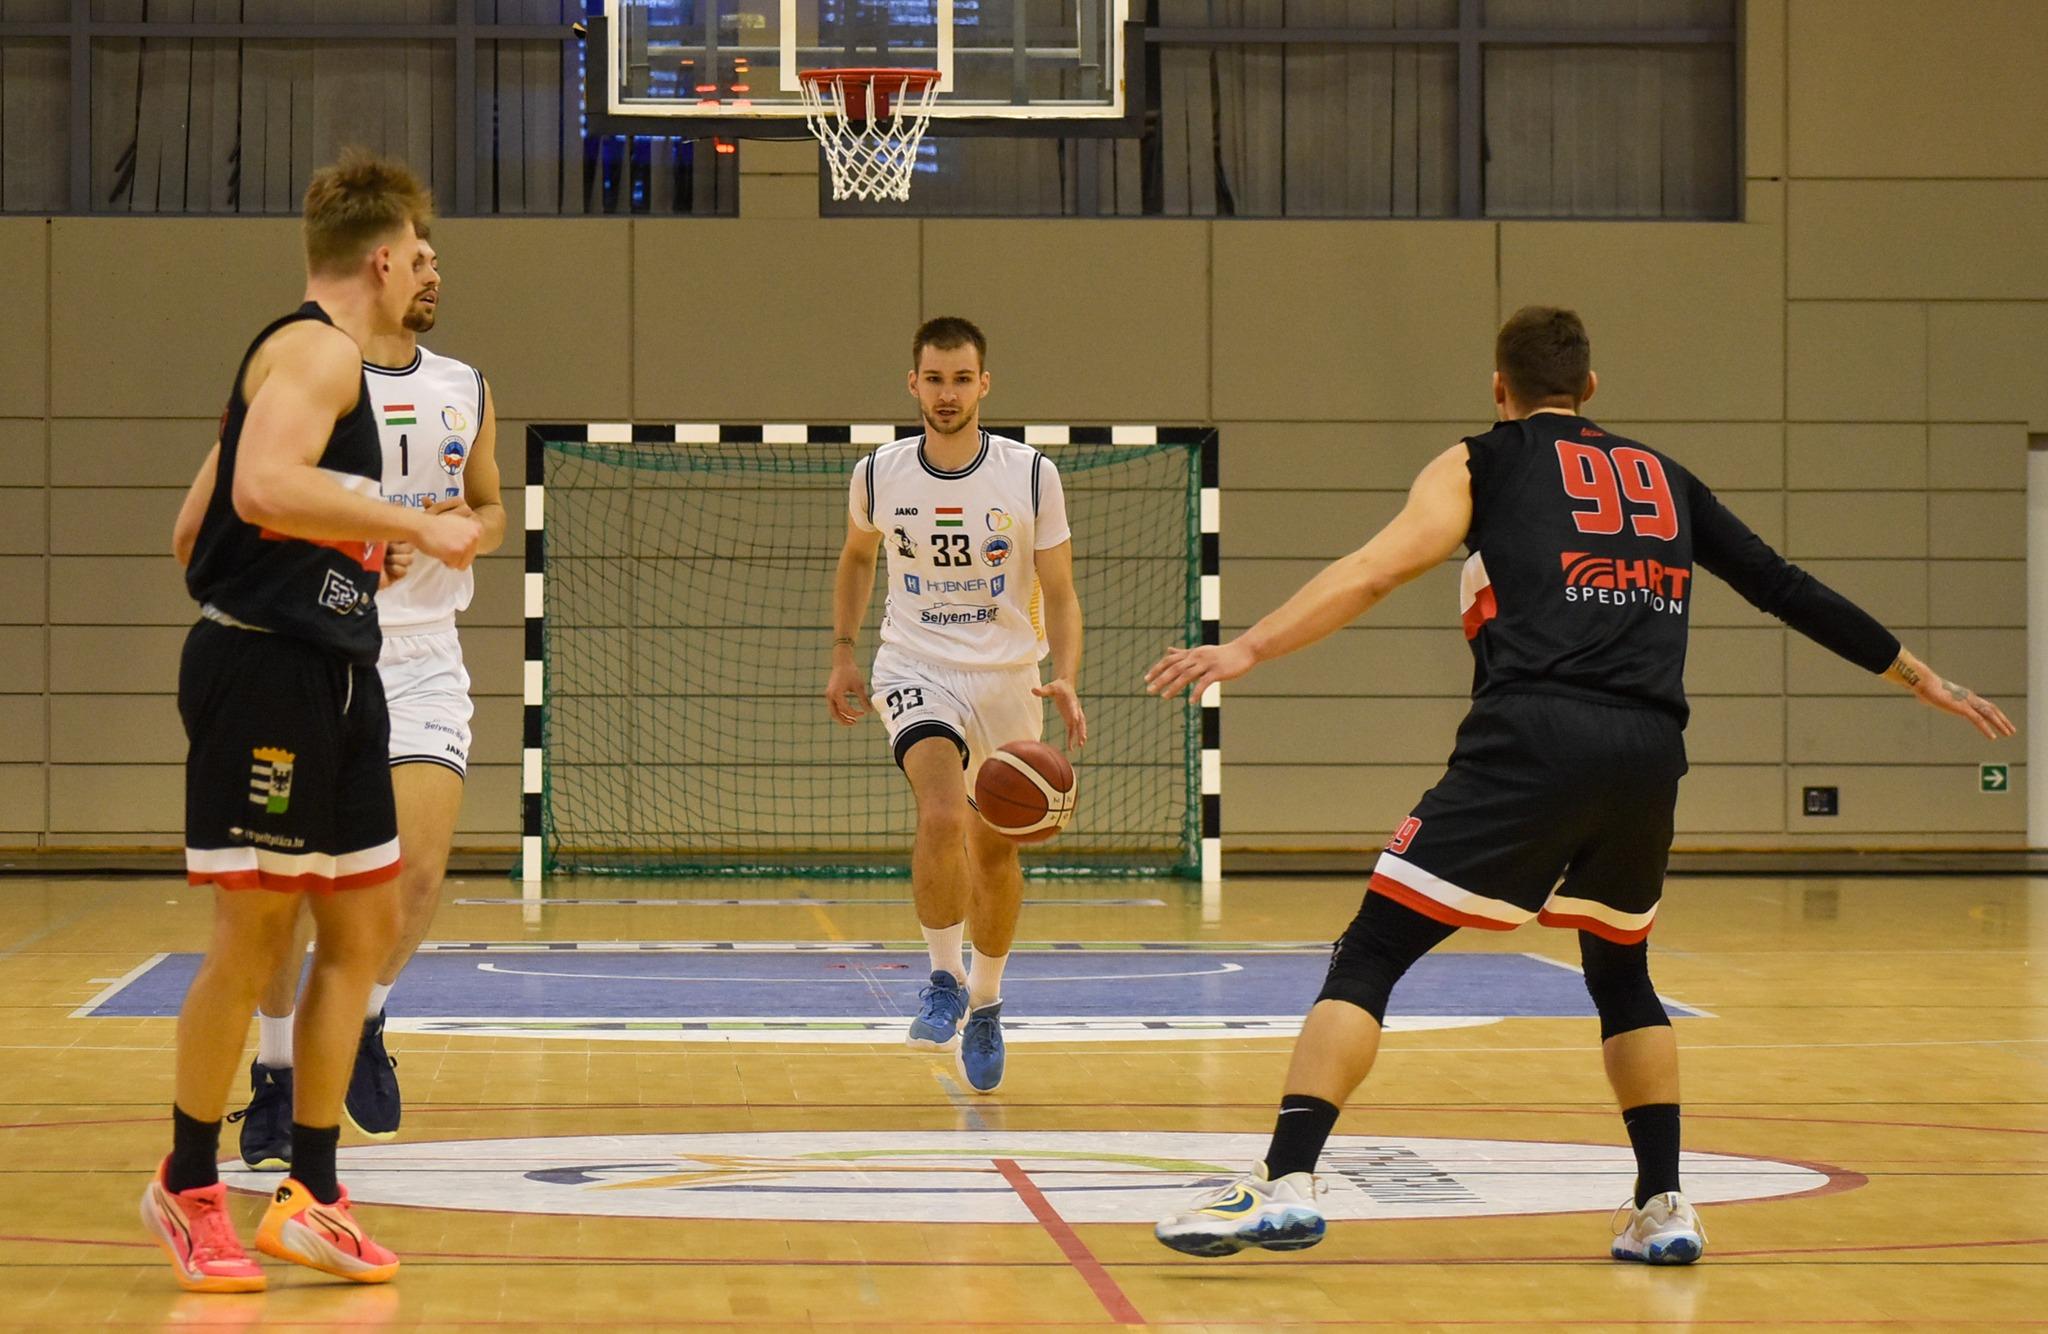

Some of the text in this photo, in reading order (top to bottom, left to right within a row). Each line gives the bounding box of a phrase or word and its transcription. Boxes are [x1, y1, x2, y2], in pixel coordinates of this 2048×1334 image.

[399, 434, 408, 476] 1
[1555, 440, 1679, 541] 99
[894, 507, 919, 516] JAKO
[931, 534, 972, 567] 33
[1615, 559, 1690, 599] HRT
[1565, 586, 1684, 616] SPEDITION
[886, 687, 924, 721] 33
[445, 743, 465, 760] JAKO
